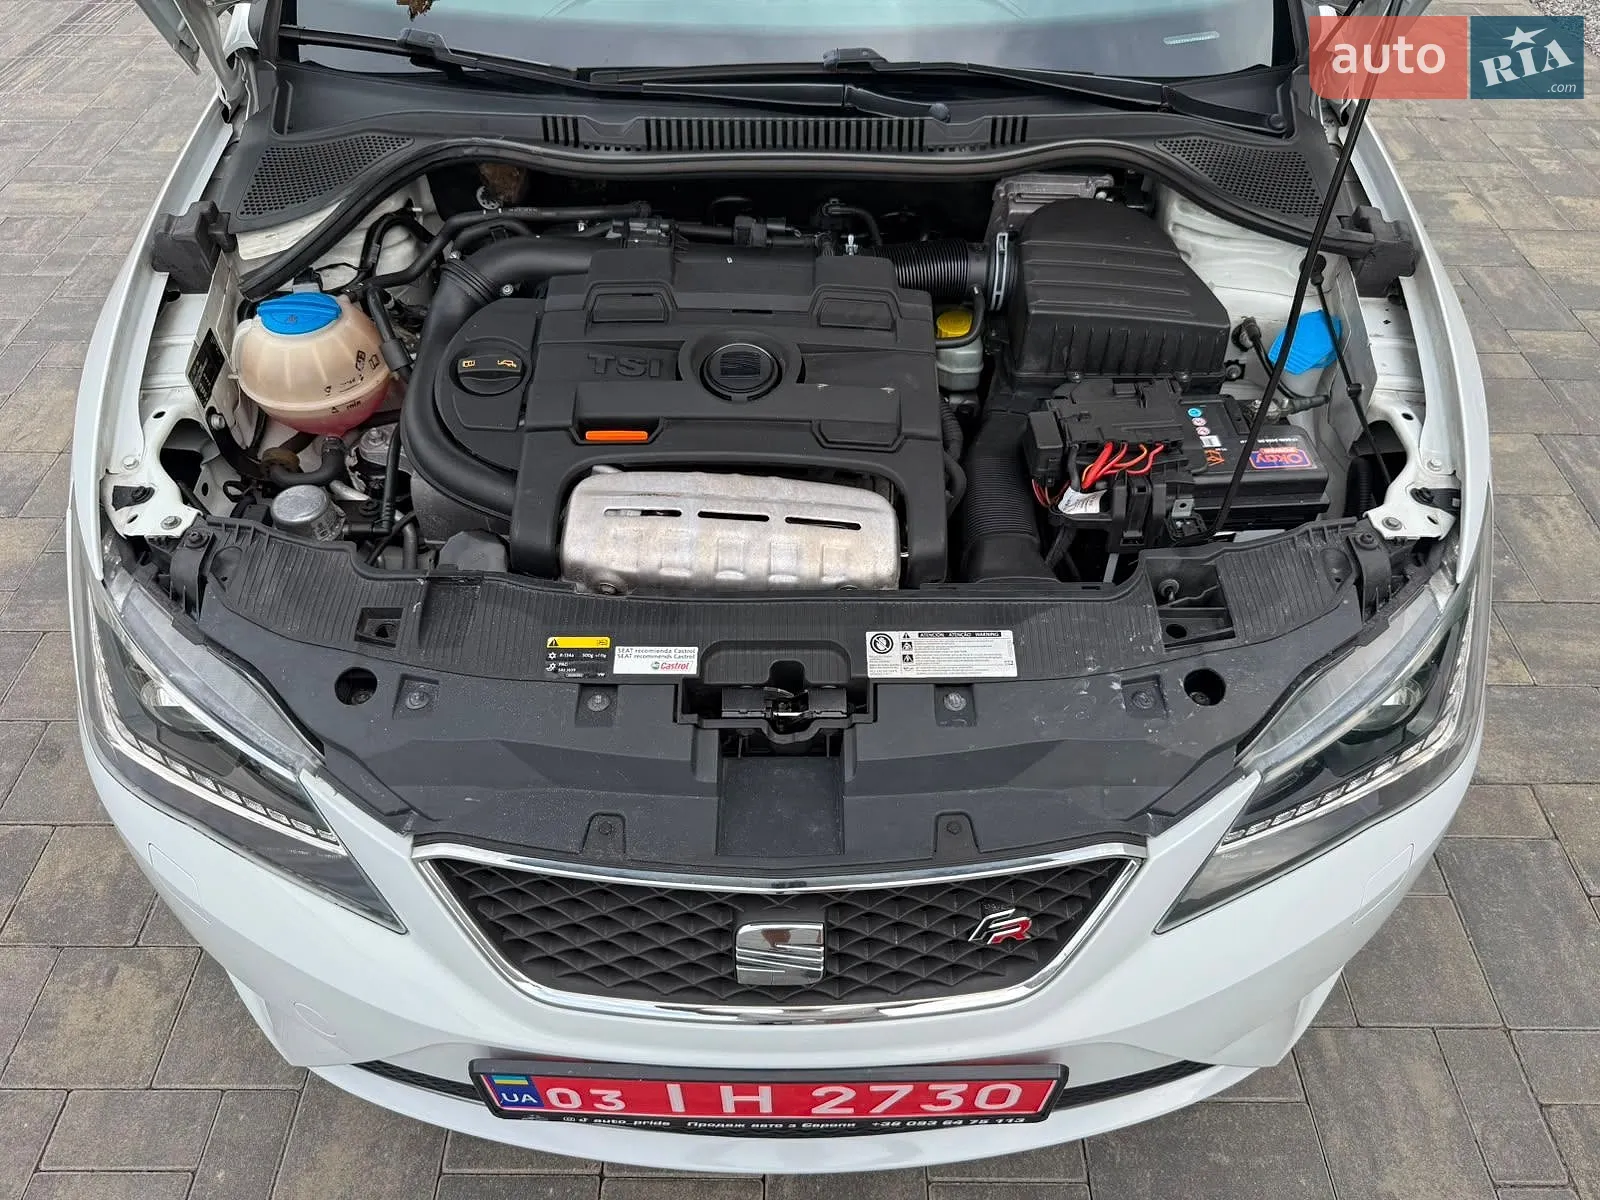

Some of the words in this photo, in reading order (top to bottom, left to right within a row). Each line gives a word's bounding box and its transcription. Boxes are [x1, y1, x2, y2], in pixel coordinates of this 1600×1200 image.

[587, 352, 661, 378] TSI
[661, 662, 690, 671] Castrol
[968, 908, 1032, 945] FR
[501, 1092, 538, 1104] UA
[545, 1087, 626, 1111] 03
[811, 1083, 1023, 1114] 2730
[687, 1121, 746, 1129] Продаж
